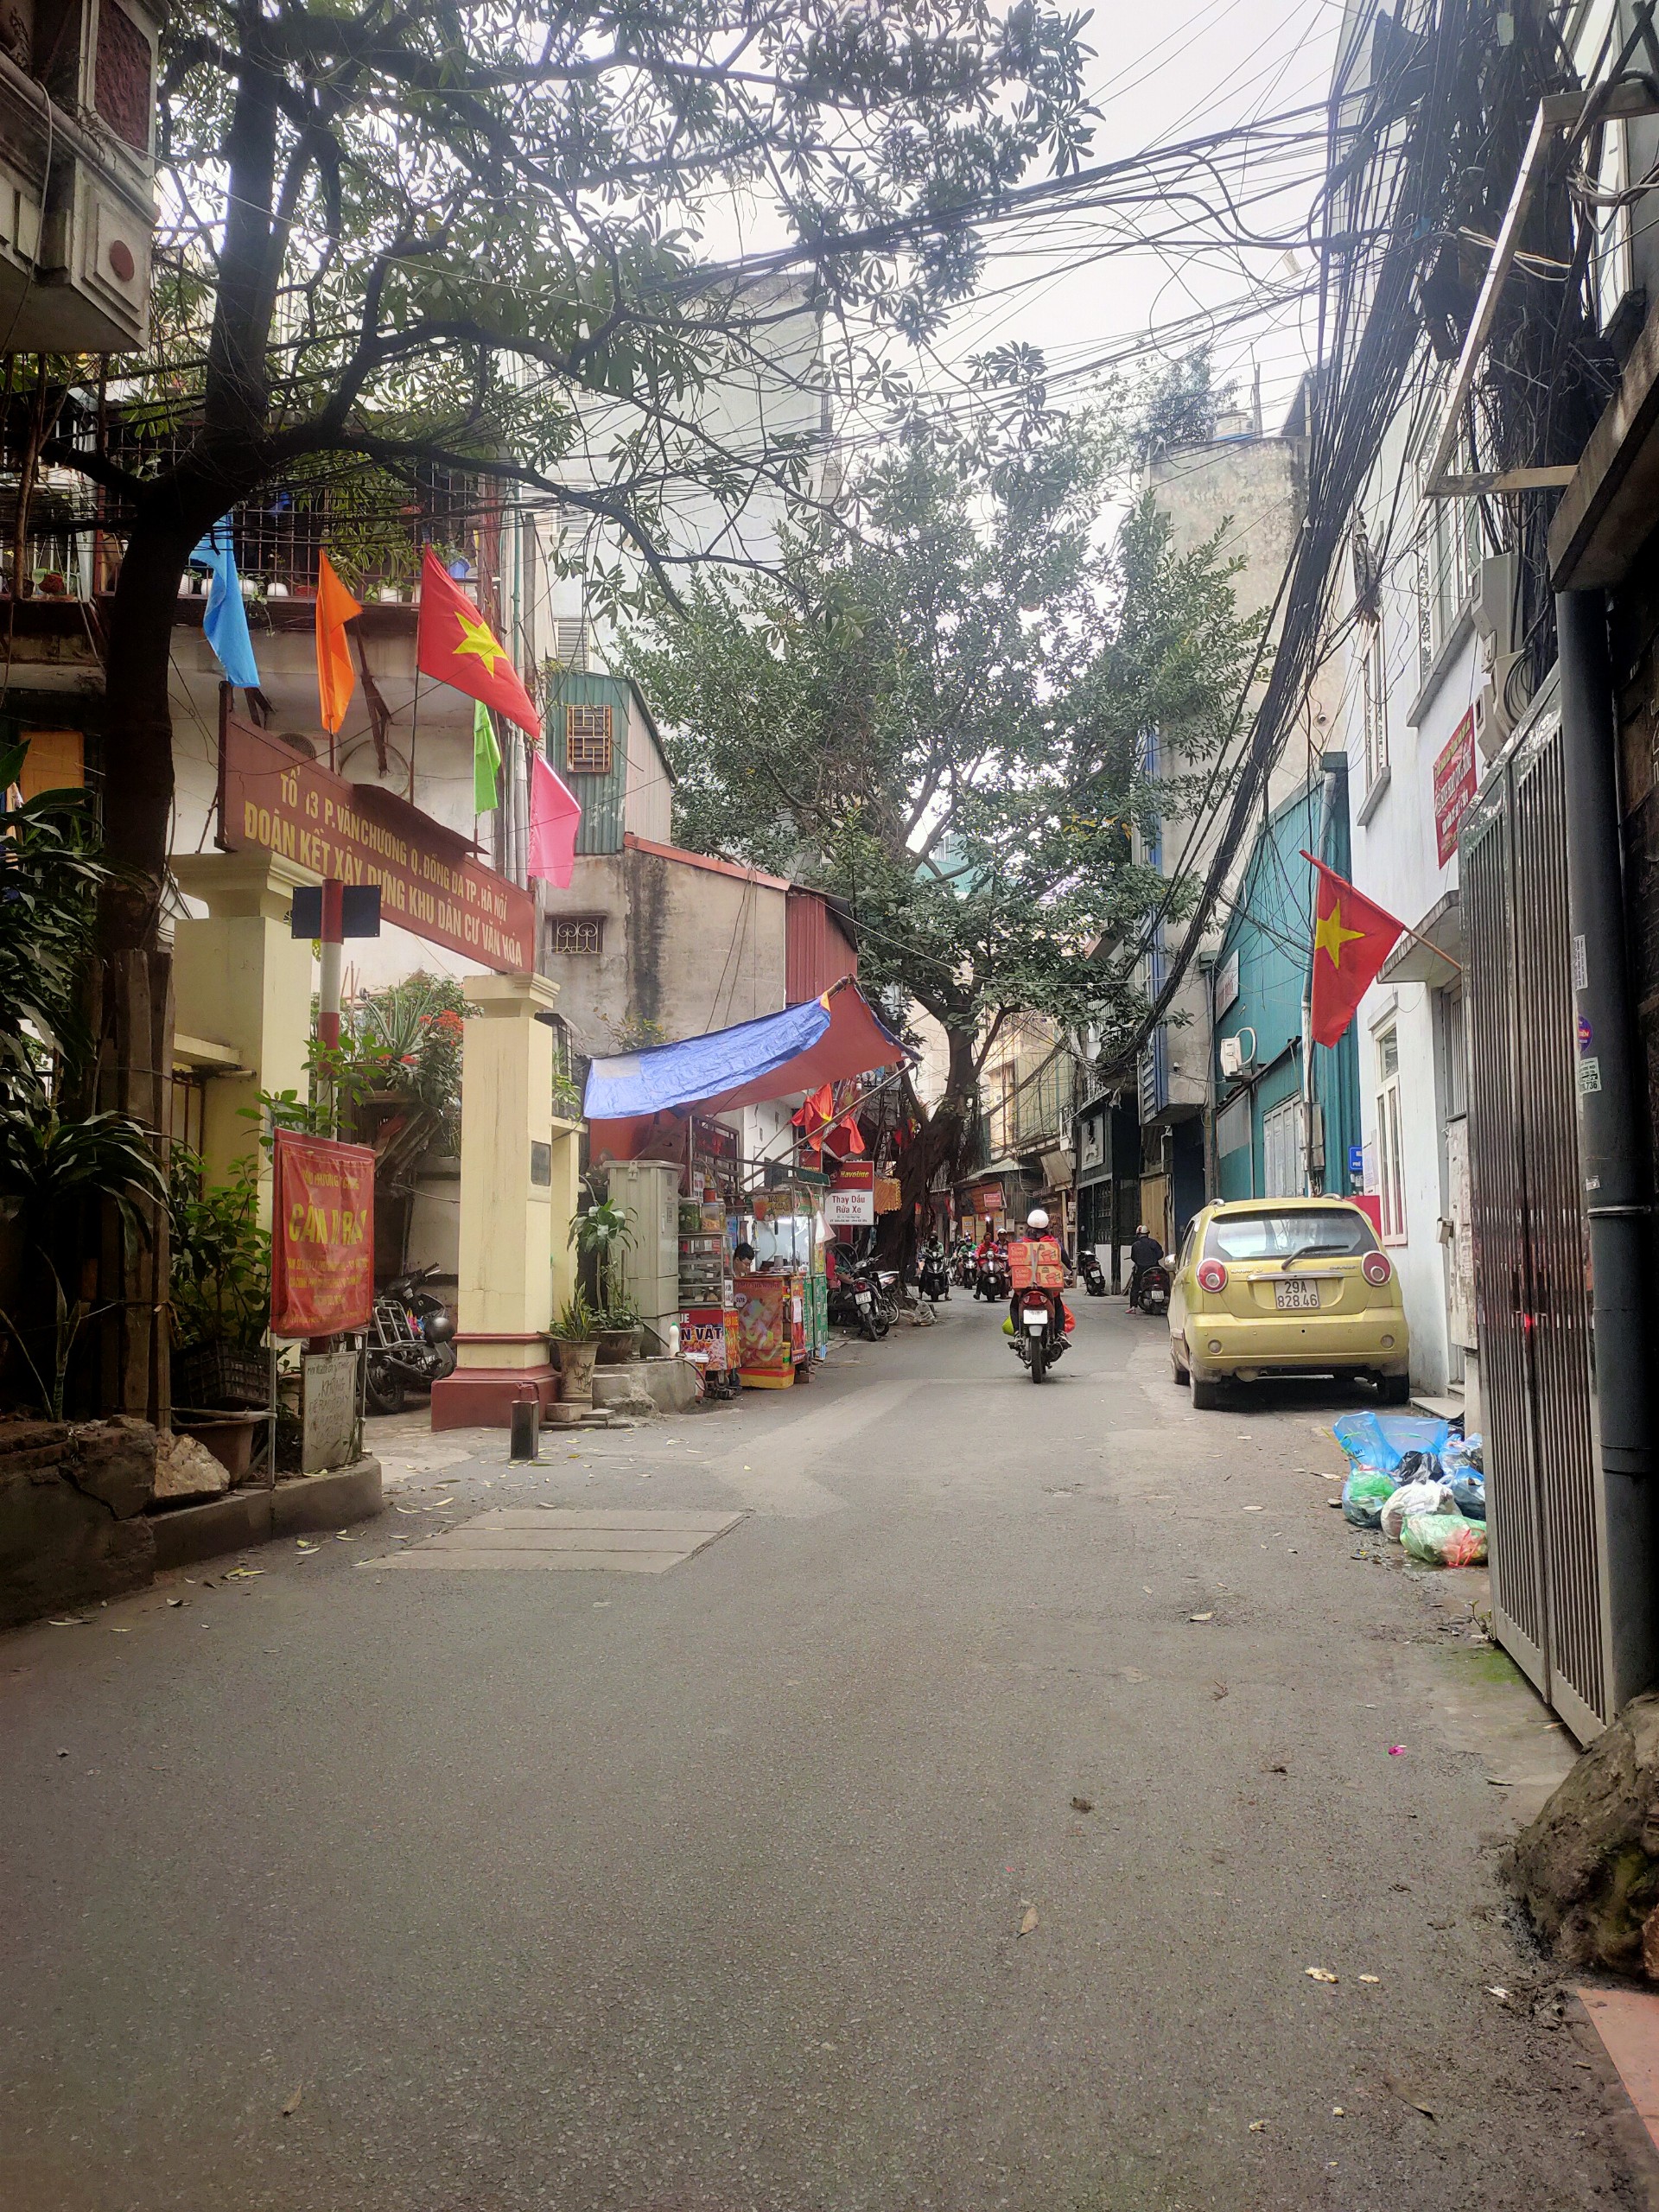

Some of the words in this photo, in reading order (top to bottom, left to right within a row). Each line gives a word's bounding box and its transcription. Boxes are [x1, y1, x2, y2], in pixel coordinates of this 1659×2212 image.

[280, 765, 301, 808] TỔ
[305, 791, 319, 819] 13
[493, 893, 508, 925] NỘI
[244, 800, 296, 859] ĐOÀN
[300, 828, 331, 875] KẾT
[334, 844, 363, 886] XÂY
[409, 884, 435, 925] KHU
[437, 898, 461, 938] DÂN
[464, 913, 480, 945] CƯ
[481, 919, 501, 957] VĂN
[840, 1170, 869, 1179] Havoline
[832, 1195, 849, 1205] Thay
[852, 1205, 861, 1214] Xe
[1284, 1281, 1307, 1294] 29A
[1277, 1294, 1318, 1307] 828.46
